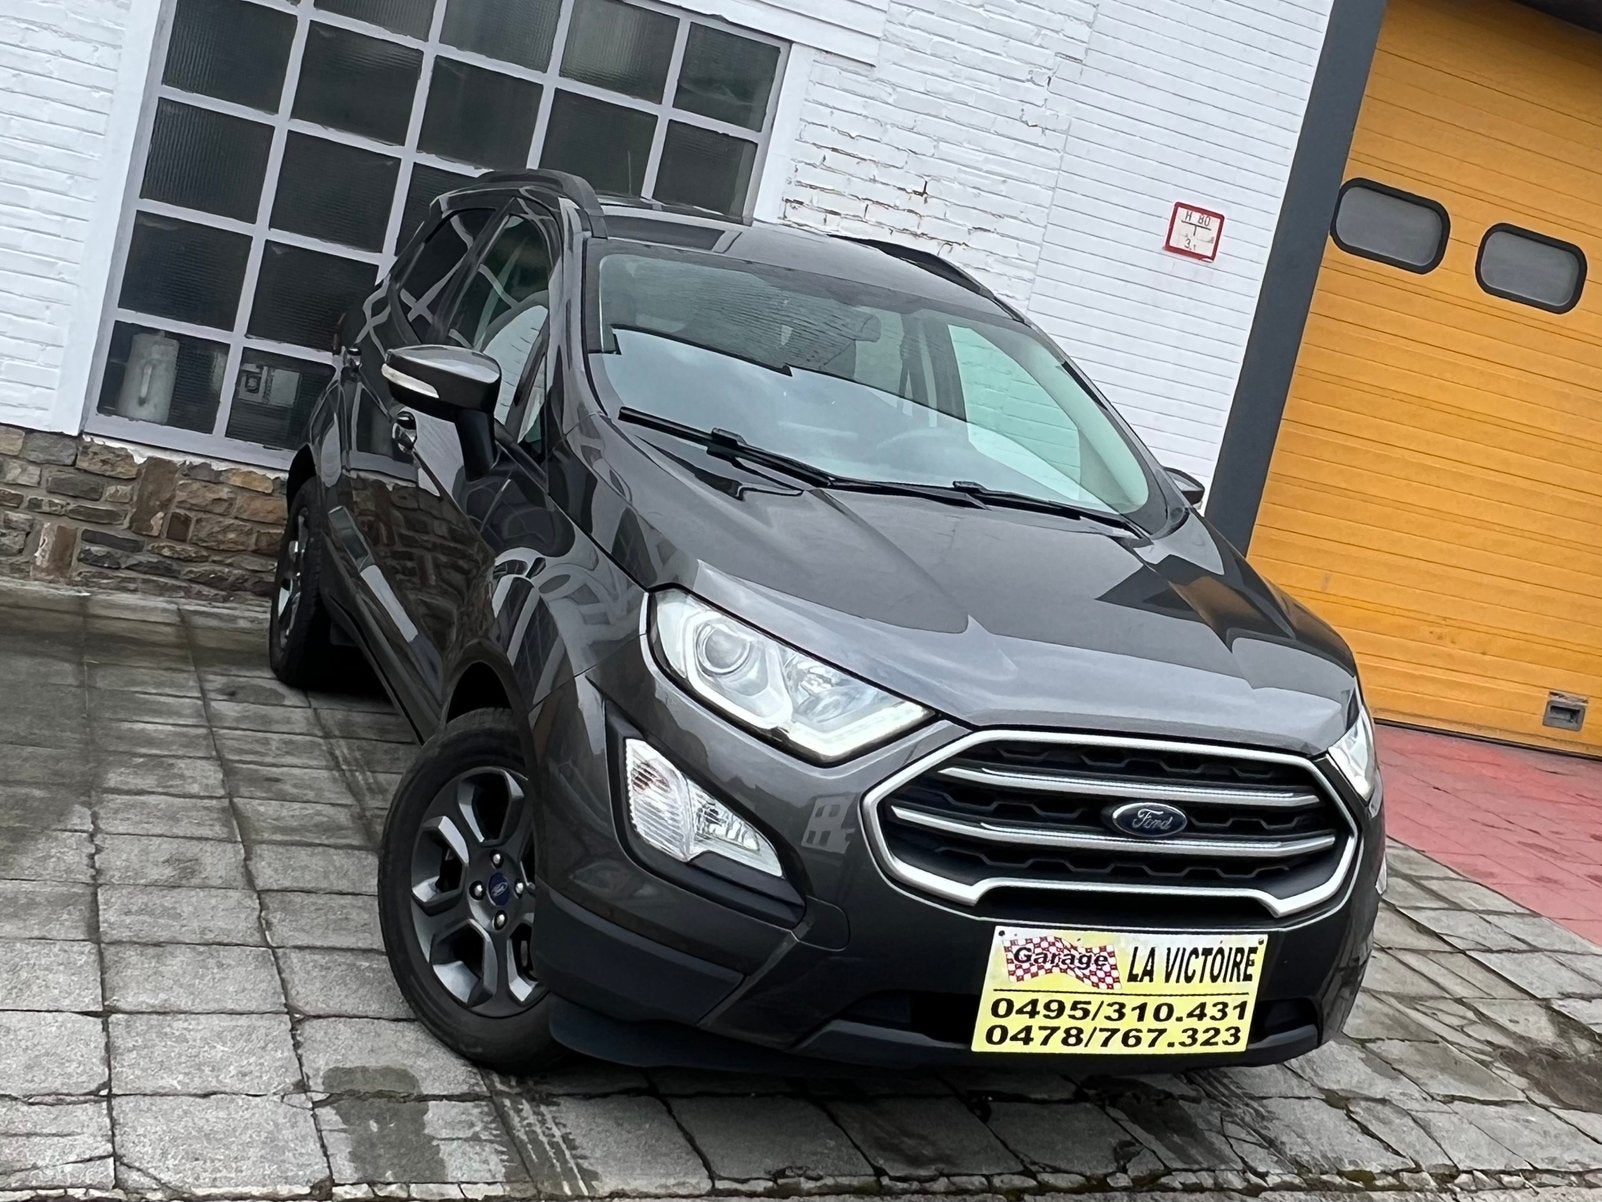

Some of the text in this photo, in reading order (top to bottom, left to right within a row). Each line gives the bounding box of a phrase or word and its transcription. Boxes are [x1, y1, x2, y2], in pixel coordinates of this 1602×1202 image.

[1184, 210, 1211, 227] H 80
[1132, 808, 1173, 829] Ford
[1013, 946, 1259, 984] Garage LA VICTOIRE
[990, 998, 1248, 1022] 0495/310.431
[985, 1025, 1241, 1048] 0478/767.323
